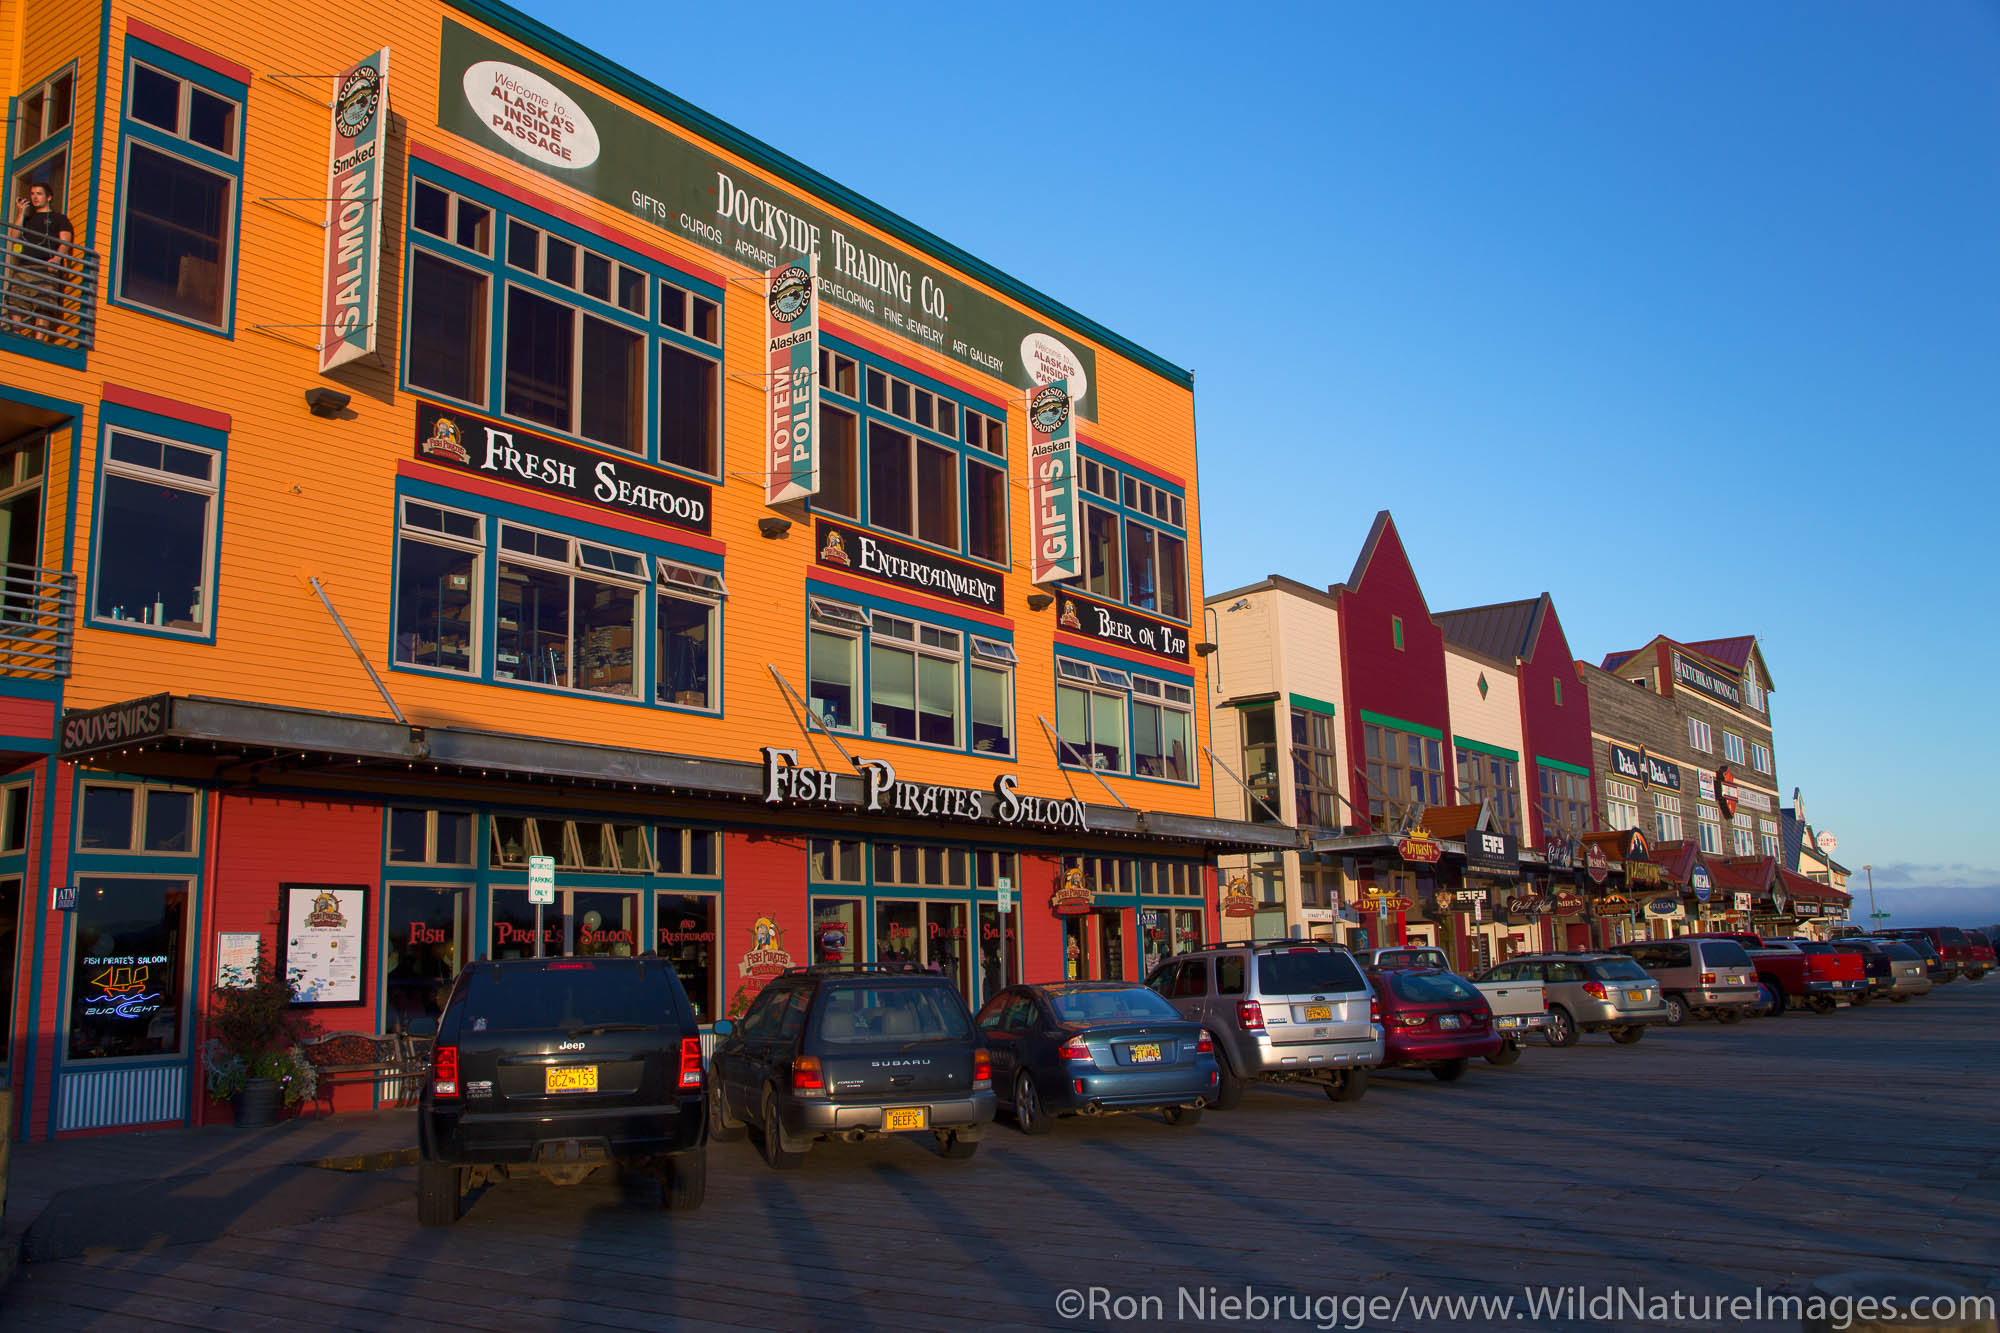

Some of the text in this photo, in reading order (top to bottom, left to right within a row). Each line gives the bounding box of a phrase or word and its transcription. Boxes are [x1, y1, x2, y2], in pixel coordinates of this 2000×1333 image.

[339, 67, 378, 101] DOCKSIDE
[495, 71, 549, 107] Welcome
[491, 86, 575, 134] ALASKA'S
[337, 111, 369, 136] TRADING
[504, 105, 561, 142] INSIDE
[493, 114, 572, 161] PASSAGE
[333, 142, 375, 175] Smoked
[334, 170, 367, 337] SALMON
[717, 172, 948, 322] DOCKSIDE TRADING CO.
[632, 190, 666, 218] GIFTS
[680, 213, 722, 245] CURIOS
[818, 276, 875, 313] DEVELOPING
[884, 307, 903, 327] FINE
[906, 318, 943, 345] JEWELRY
[953, 339, 968, 356] ART
[970, 346, 1004, 373] GALLERY
[772, 267, 810, 293] DOCKSIDE
[770, 301, 802, 322] TRADING
[770, 331, 811, 352] Alaskan
[1034, 350, 1075, 377] ALASKA'S
[1032, 388, 1067, 409] DOCKSIDE
[774, 365, 790, 472] TOTEM
[793, 366, 809, 462] POLES
[1031, 415, 1061, 433] TRADING
[1032, 440, 1070, 457] Alaskan
[481, 426, 705, 522] FRESH SEAFOOD
[1039, 458, 1067, 560] GIFTS
[858, 536, 996, 605] ENTERTAINMENT
[1094, 606, 1137, 644] BEER
[1139, 627, 1156, 650] ON
[1161, 626, 1186, 655] TAP
[1681, 662, 1713, 690] KETCHIKAN
[1713, 678, 1732, 701] MINING
[63, 702, 161, 749] SOUVENIRS
[765, 747, 1090, 832] FISH PIRATES SALOON
[530, 876, 553, 884] PARKING
[58, 888, 75, 900] ATM
[534, 889, 548, 897] ONLY
[680, 920, 696, 929] AND
[1141, 913, 1158, 921] ATM
[408, 922, 633, 945] FISH PIRAE'S SALOON
[659, 928, 716, 945] RESTAURANT
[889, 922, 910, 940] FISH
[983, 923, 1016, 941] SALON
[84, 955, 167, 965] FISH PIRATE'S SALOON
[747, 953, 763, 966] FISH
[85, 1004, 160, 1015] BUD LIGHT
[559, 1041, 585, 1050] Jeep
[871, 1059, 931, 1067] SUBARU
[548, 1073, 596, 1089] GCZ 153
[892, 1115, 918, 1127] BEEFS
